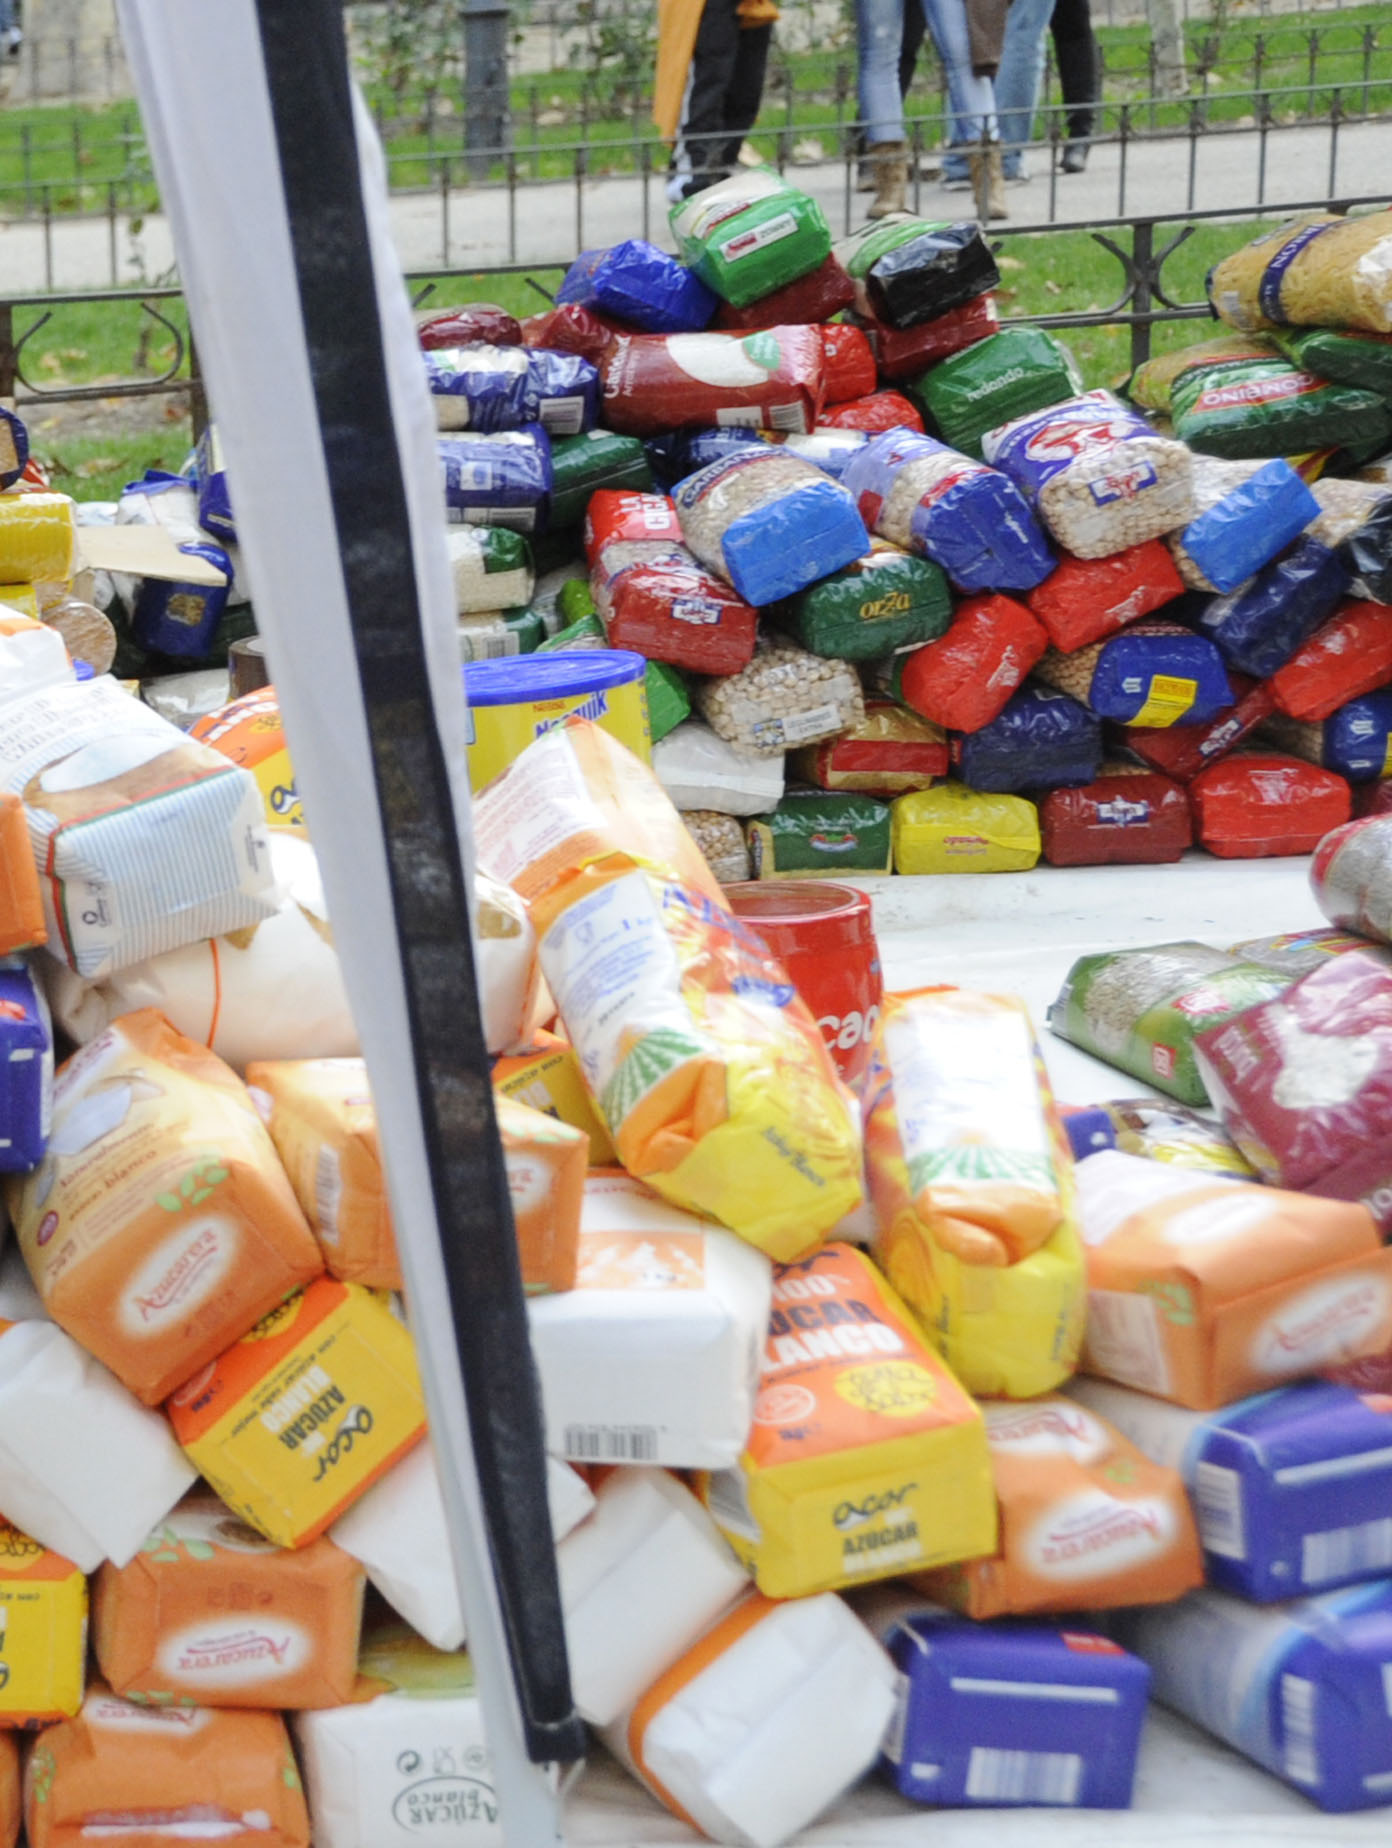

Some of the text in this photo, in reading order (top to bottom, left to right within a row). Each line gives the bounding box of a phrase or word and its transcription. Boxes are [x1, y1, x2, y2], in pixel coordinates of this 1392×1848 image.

[968, 367, 1025, 402] redondo
[1203, 375, 1315, 405] COMBINO
[135, 1227, 218, 1323] Azucarera
[759, 1321, 905, 1375] LANCO
[260, 1364, 332, 1434] BLANCO
[278, 1384, 347, 1450] AZÚCAR
[312, 1403, 374, 1484] acor
[832, 1482, 919, 1531] acor
[177, 1635, 292, 1671] Azucarera
